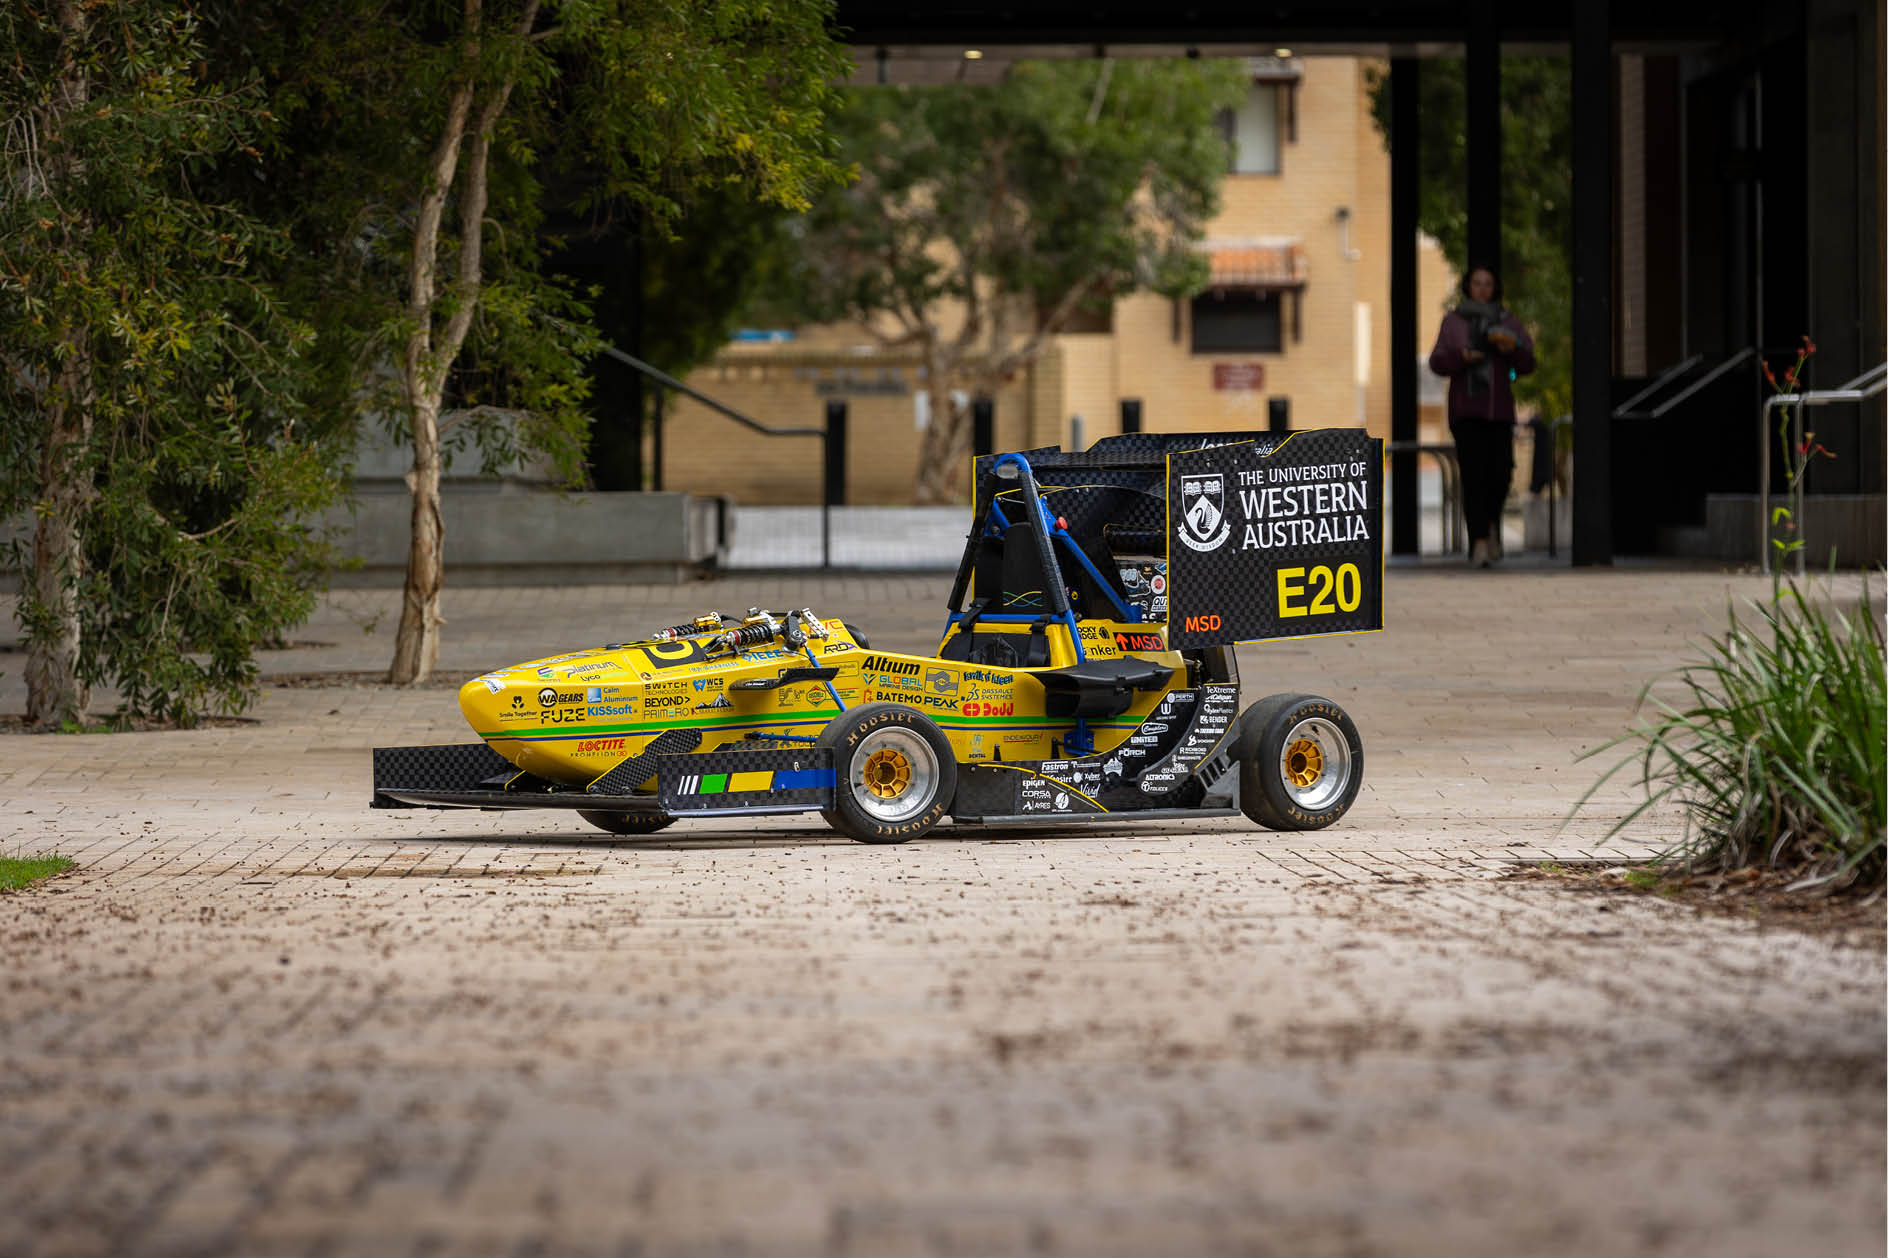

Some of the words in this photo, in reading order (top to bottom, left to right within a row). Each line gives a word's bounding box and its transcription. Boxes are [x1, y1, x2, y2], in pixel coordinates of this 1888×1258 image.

[1238, 470, 1264, 486] THE
[1269, 464, 1346, 483] UNIVERSITY
[1350, 462, 1367, 477] OF
[1239, 480, 1368, 519] WESTERN
[1242, 514, 1370, 550] AUSTRALIA
[1277, 562, 1362, 618] E20
[1185, 615, 1222, 633] MSD
[1130, 635, 1164, 650] MSD
[752, 649, 785, 661] IEEE
[861, 656, 921, 676] Altium
[706, 678, 724, 686] WCS
[880, 674, 922, 687] GLOBAL
[1206, 686, 1236, 694] TeXtreme
[538, 694, 558, 704] WA
[558, 692, 584, 703] GEARS
[604, 695, 638, 703] Aluminium
[876, 691, 922, 704] BATEMO
[924, 696, 959, 709] PEAK
[514, 710, 538, 718] Together
[541, 708, 585, 724] FUZE
[587, 705, 632, 717] KISSsoft
[643, 707, 690, 720] PRIMERO
[577, 738, 625, 753] LOCTITE
[1041, 761, 1069, 771] Fastron
